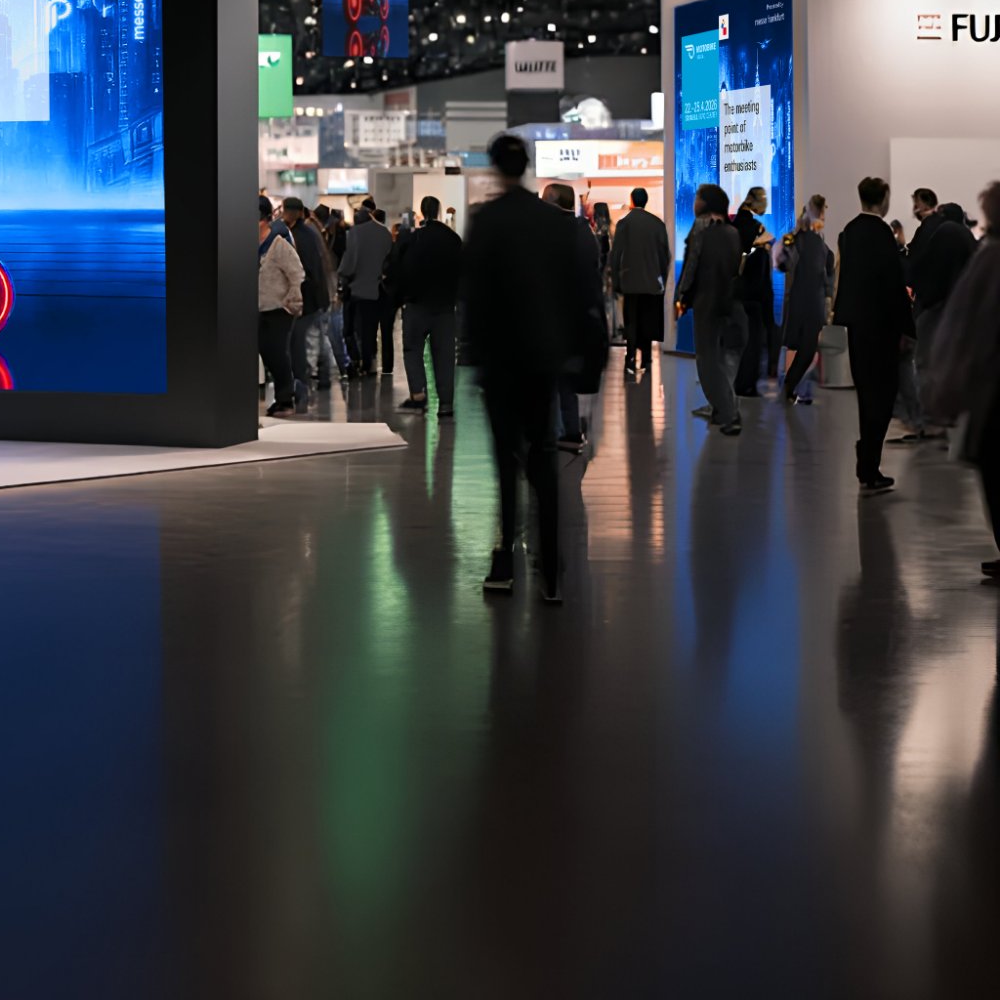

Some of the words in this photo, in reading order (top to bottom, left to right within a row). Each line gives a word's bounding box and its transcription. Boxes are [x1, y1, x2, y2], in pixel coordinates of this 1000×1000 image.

[723, 103, 735, 116] The
[735, 99, 760, 115] meeting
[739, 119, 747, 133] of
